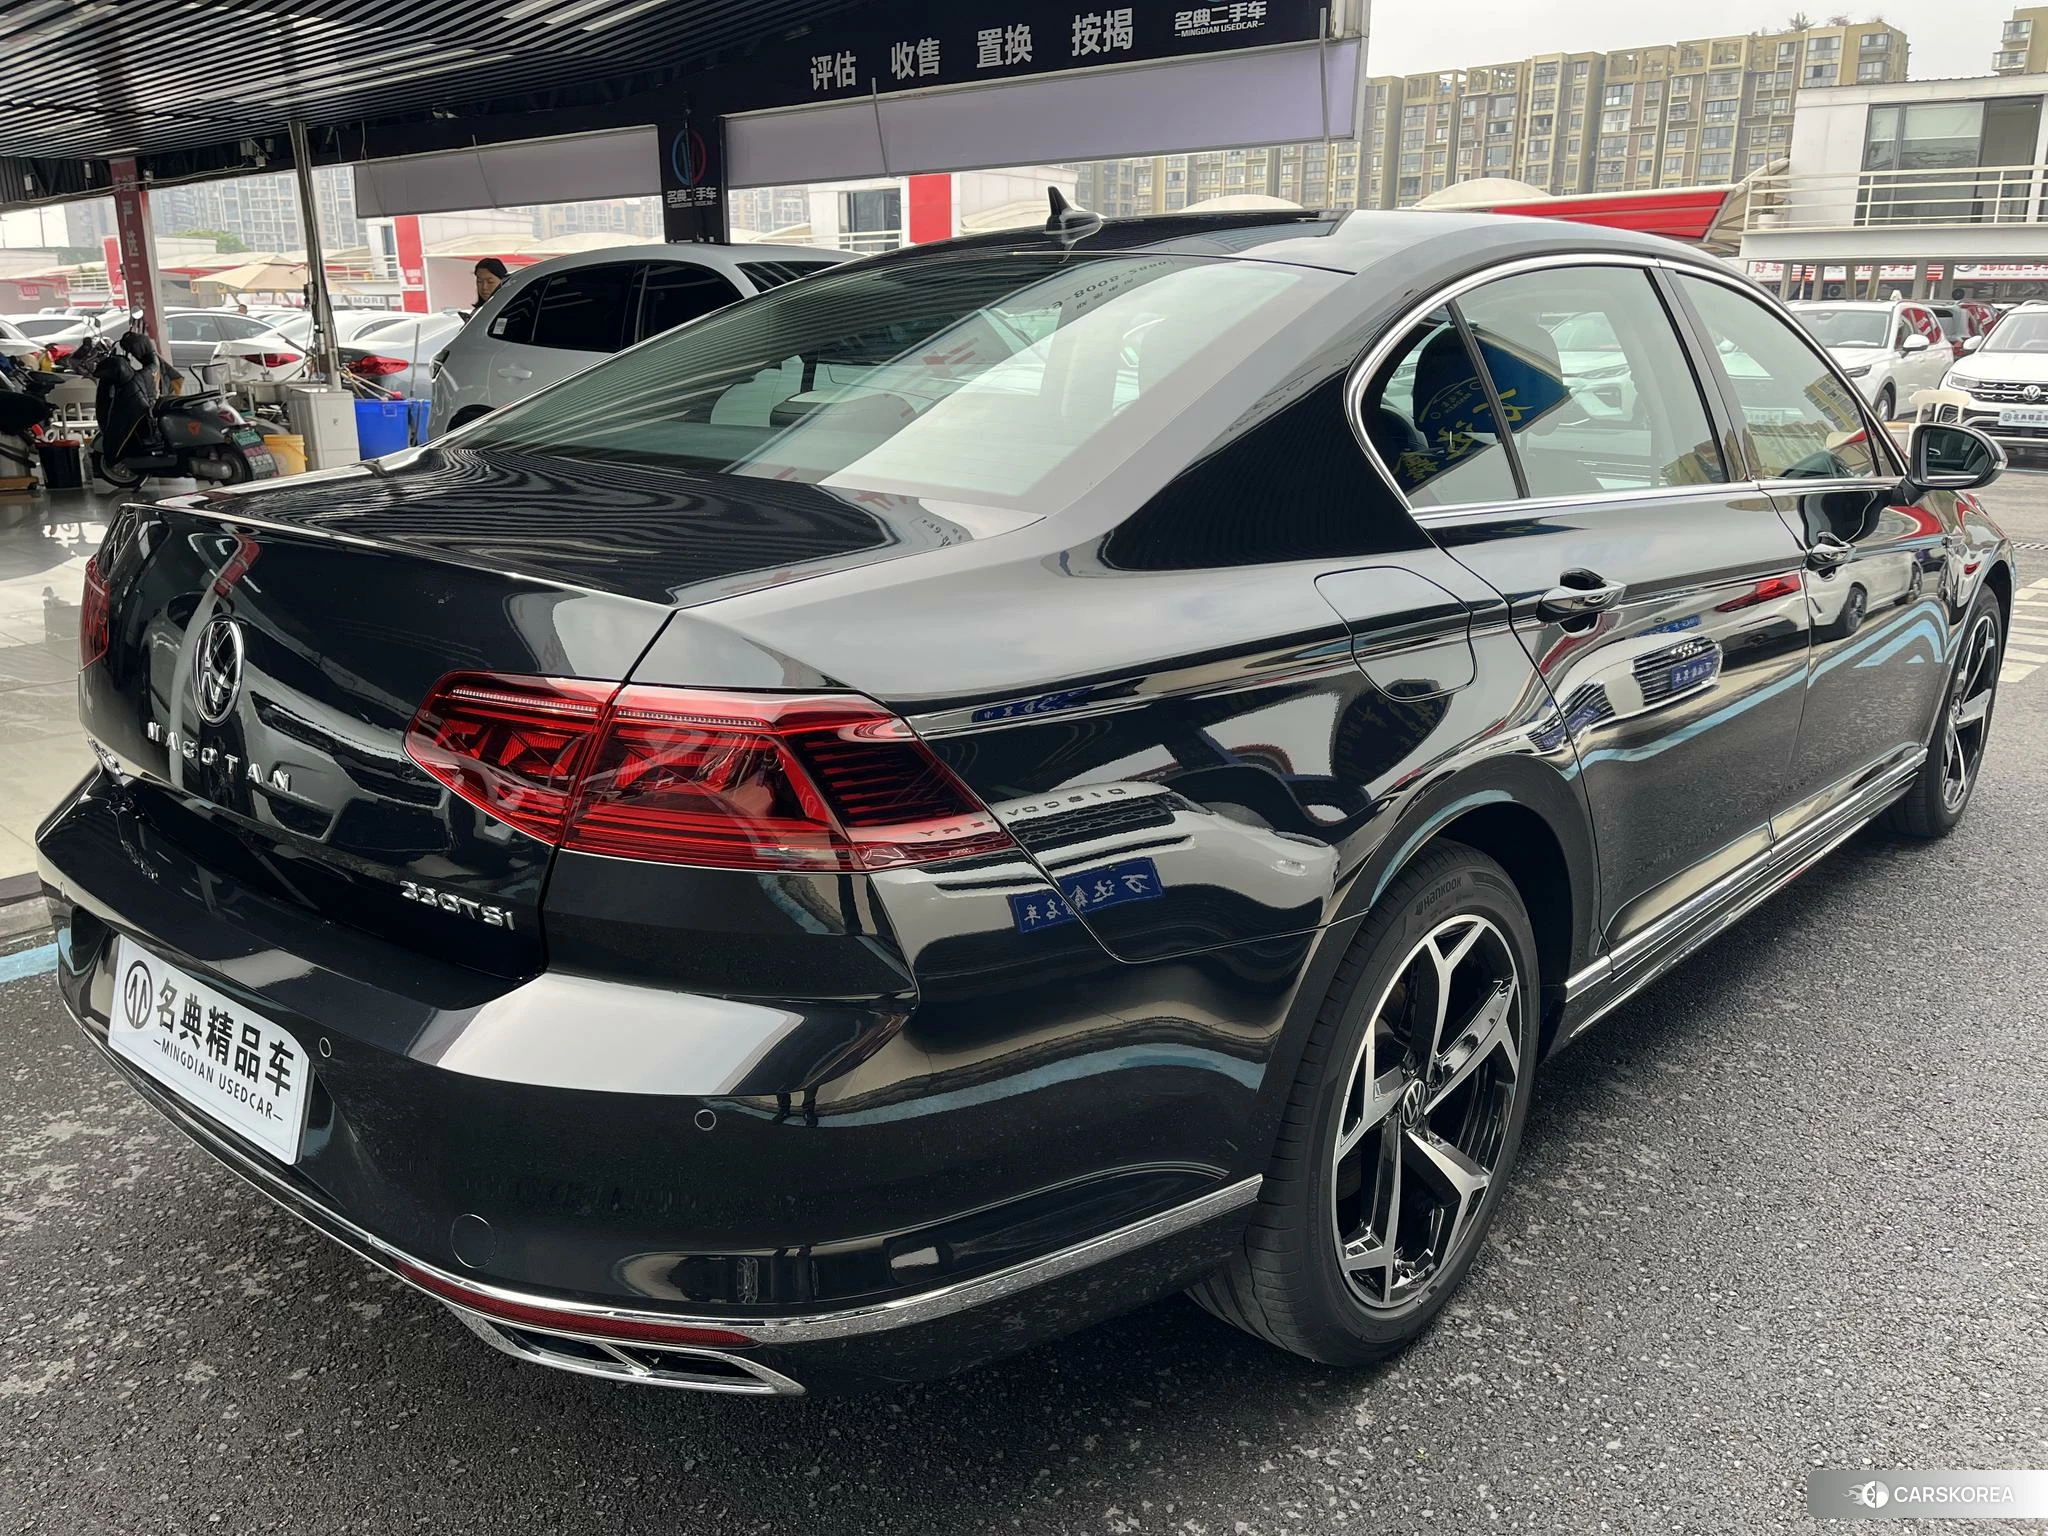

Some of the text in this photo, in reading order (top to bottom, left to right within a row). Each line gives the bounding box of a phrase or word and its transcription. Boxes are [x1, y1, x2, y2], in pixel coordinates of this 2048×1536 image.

[810, 7, 1134, 90] 评估 收售 置换 按揭
[1174, 1, 1267, 30] 名典二手车
[1180, 20, 1259, 37] MINGDIAN USEDCAR
[147, 721, 291, 792] MAGOTAN
[399, 880, 516, 931] 330TSI
[156, 976, 295, 1098] 名典精品车
[161, 1037, 273, 1120] MINGDIAN USEDCAR
